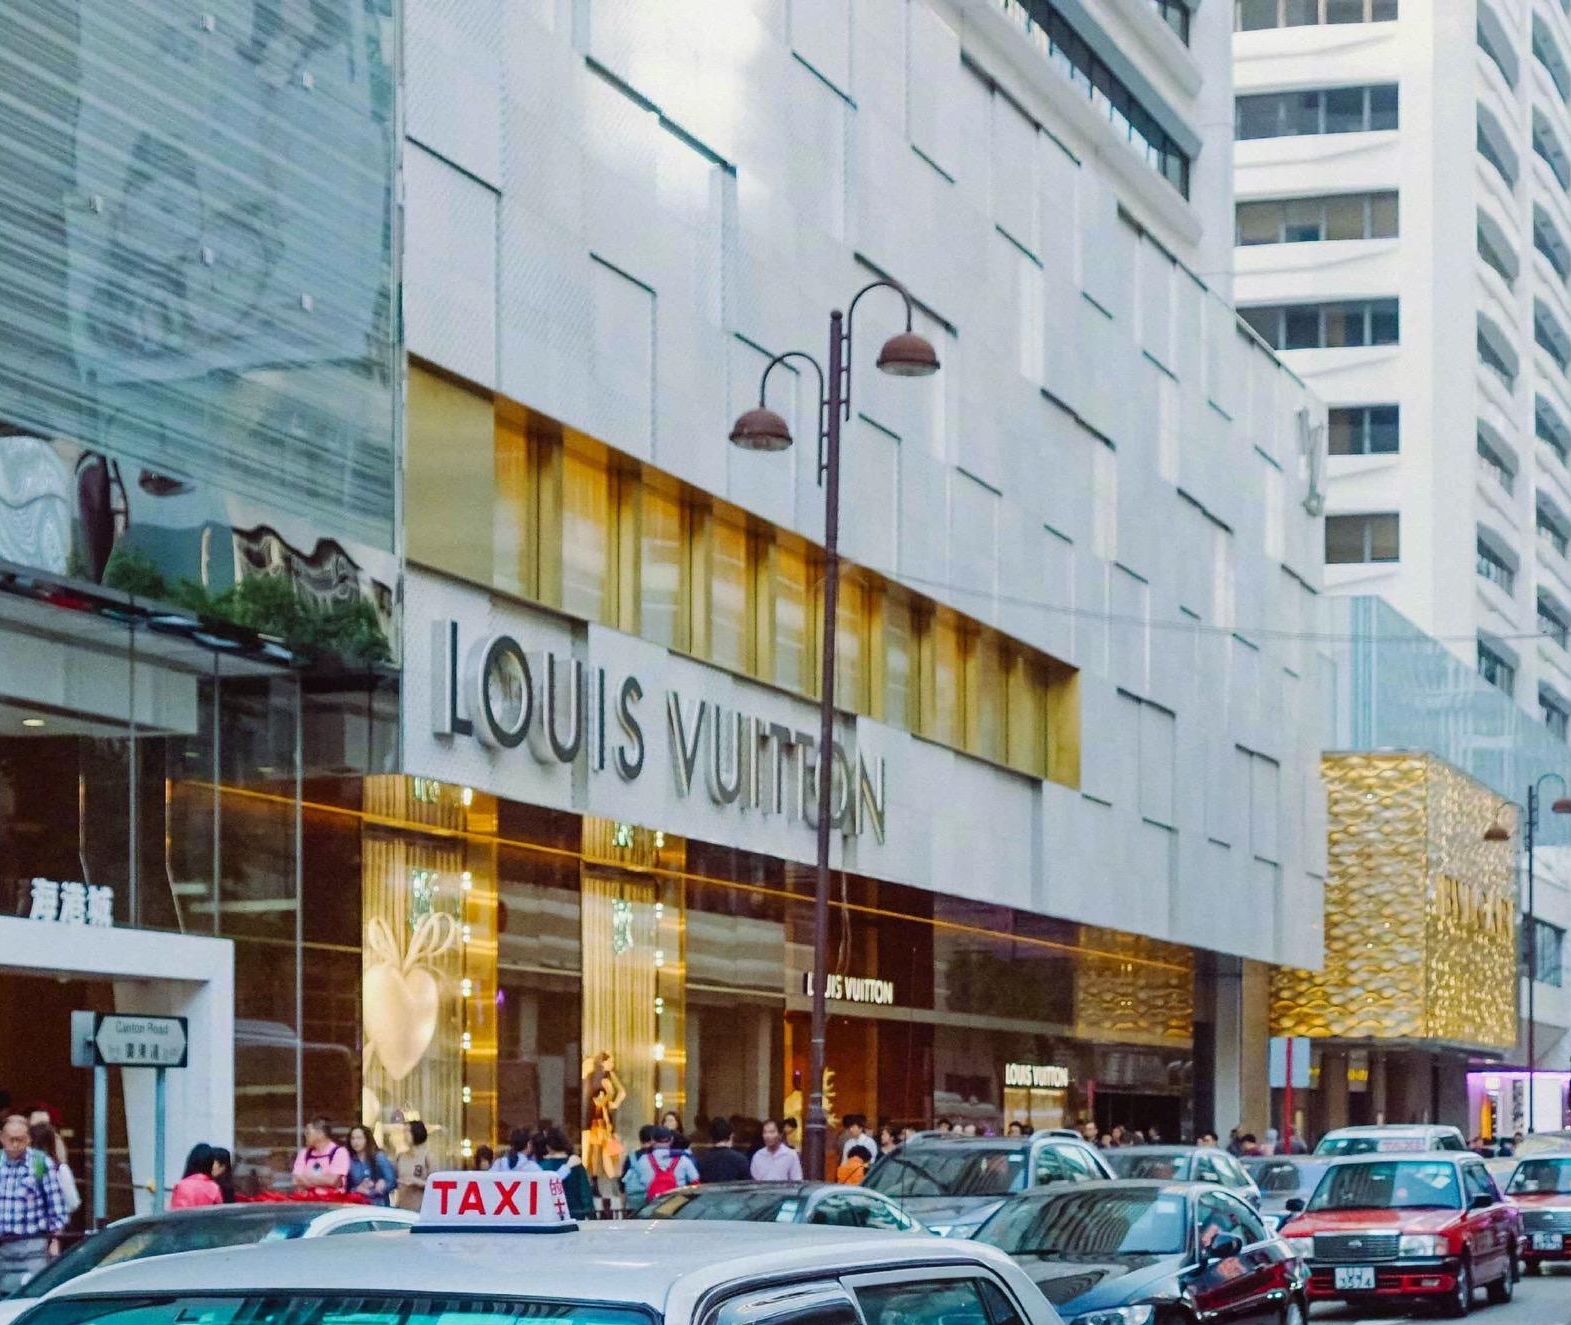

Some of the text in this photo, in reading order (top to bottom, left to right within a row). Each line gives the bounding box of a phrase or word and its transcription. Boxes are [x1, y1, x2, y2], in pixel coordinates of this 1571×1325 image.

[433, 619, 886, 845] LOUIS VUITTON
[806, 972, 894, 1004] LUIS VUITTON
[116, 1020, 169, 1035] Canton Road
[1005, 1062, 1069, 1088] LOUIS VUITTON
[432, 1181, 538, 1216] TAXI
[549, 1178, 566, 1221] 的士
